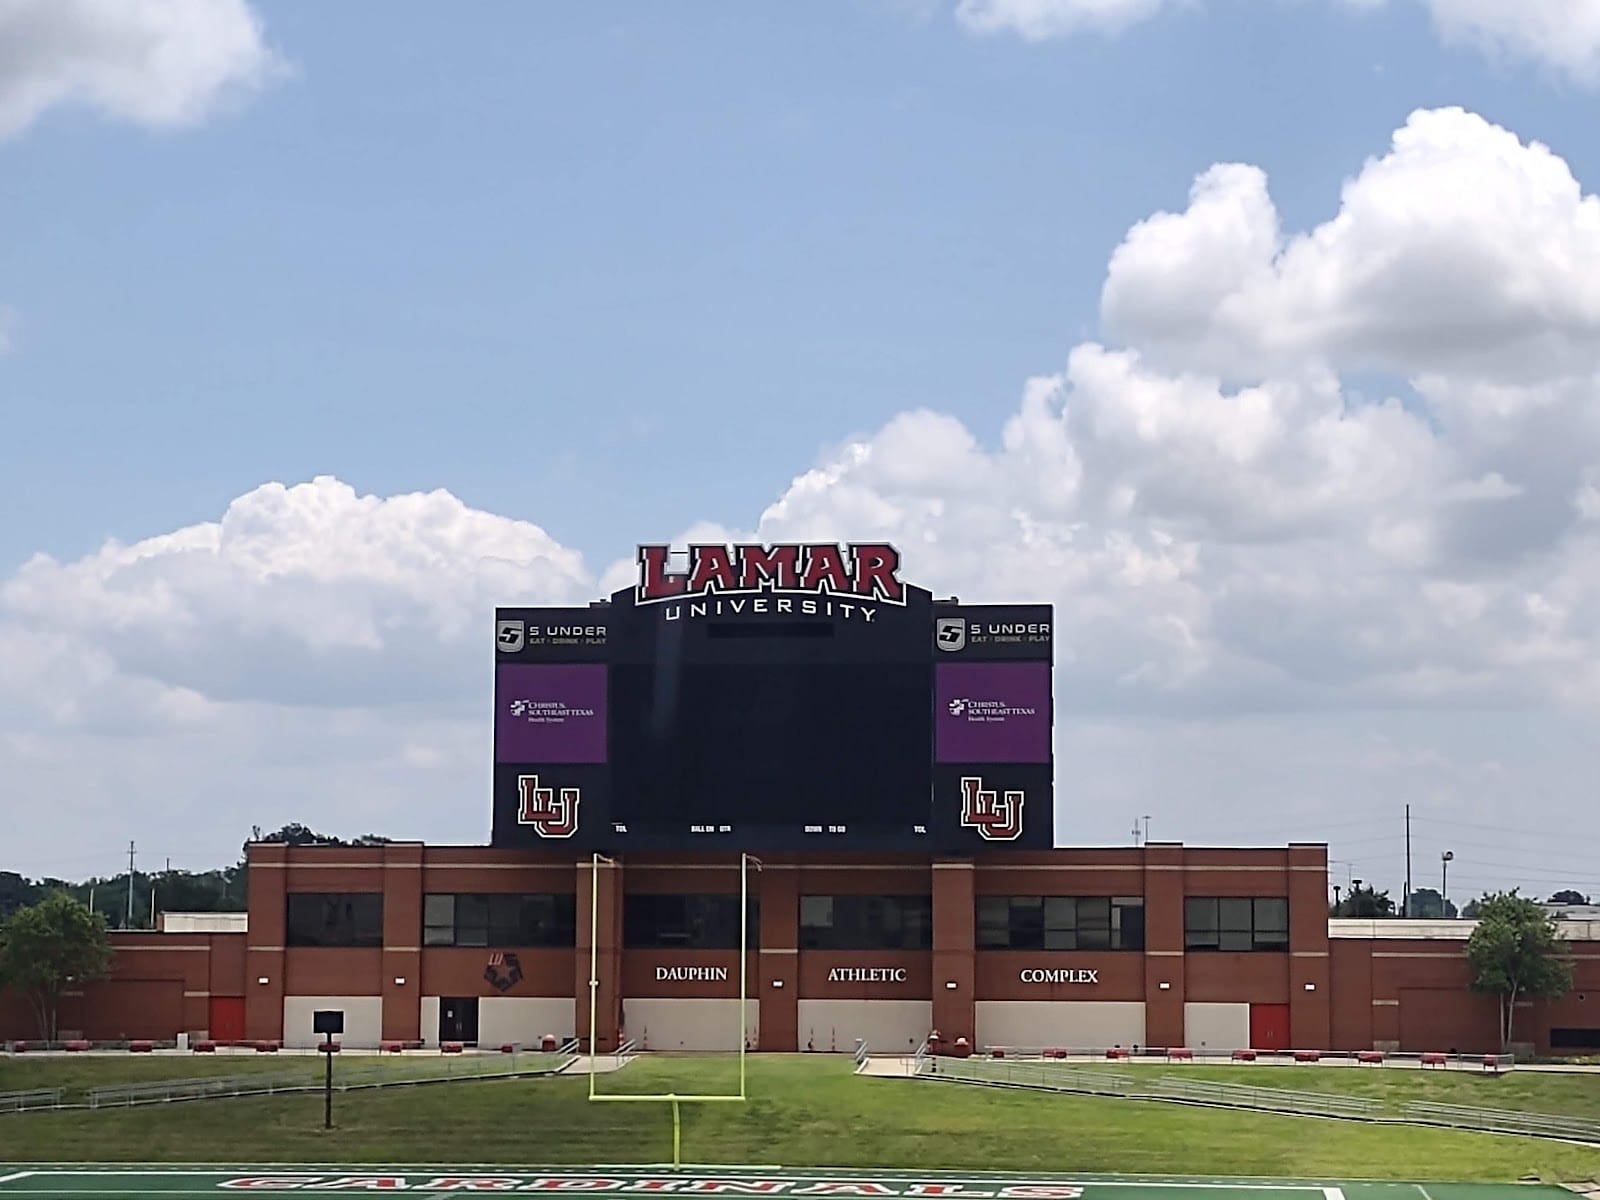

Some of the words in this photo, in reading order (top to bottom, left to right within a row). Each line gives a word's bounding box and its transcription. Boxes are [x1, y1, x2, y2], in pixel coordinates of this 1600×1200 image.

[635, 543, 907, 605] LAMAR
[666, 599, 876, 622] UNIVERSITY
[547, 626, 607, 636] UNDER
[989, 624, 1050, 634] UNDER
[518, 775, 580, 838] LU
[961, 777, 1024, 840] LU
[656, 967, 727, 980] DAUPHIN
[828, 967, 907, 982] ATHLETIC
[1020, 969, 1098, 983] COMPLEX
[217, 1176, 1084, 1199] CARDINALS
